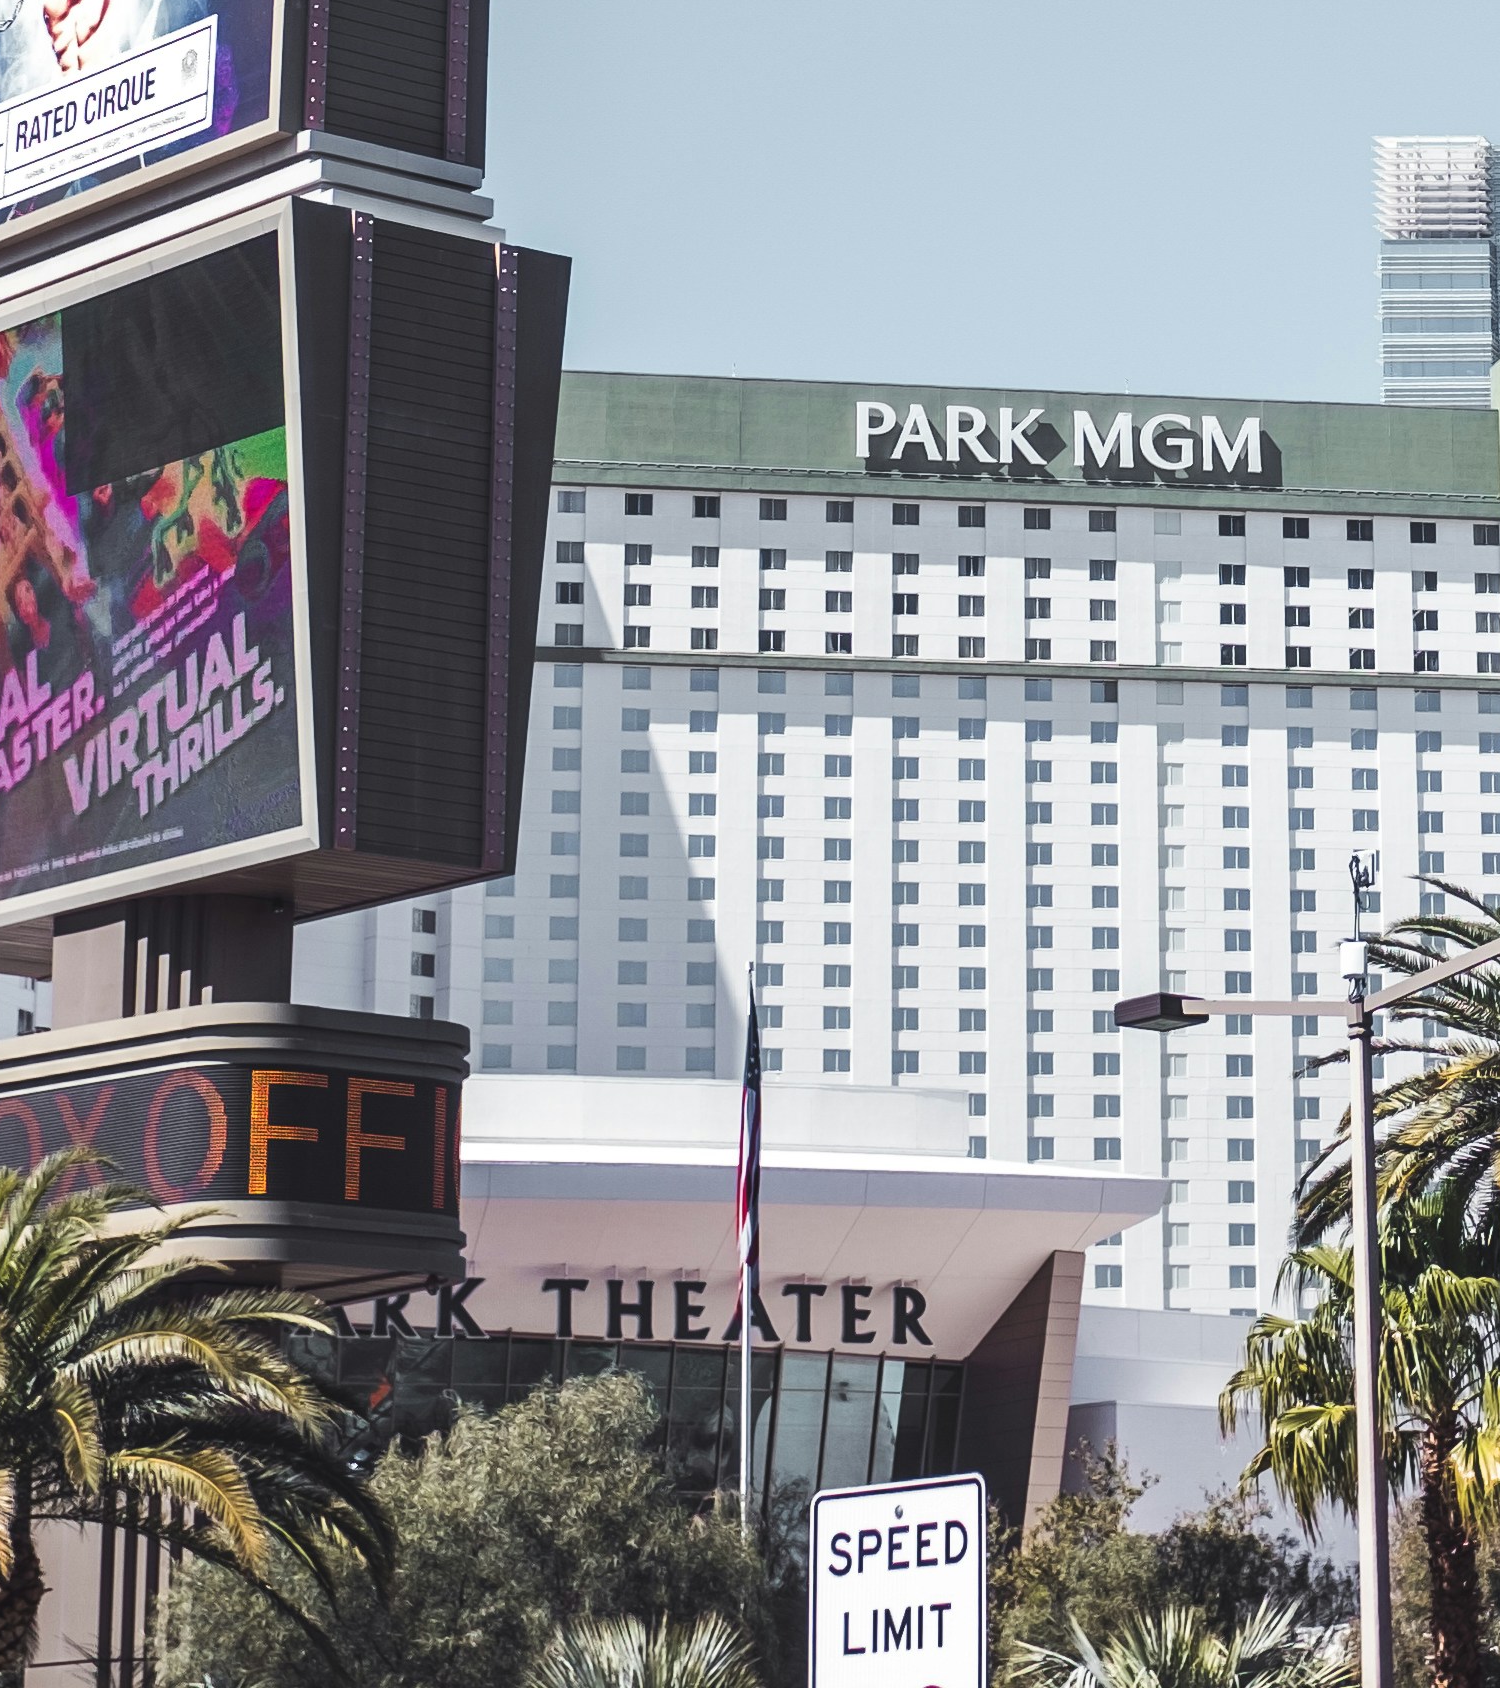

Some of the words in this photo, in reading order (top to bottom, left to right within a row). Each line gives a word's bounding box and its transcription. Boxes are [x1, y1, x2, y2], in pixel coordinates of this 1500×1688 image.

[16, 103, 77, 153] RATED
[84, 66, 157, 125] CIRQUE
[855, 400, 1048, 466] PARK
[1072, 409, 1263, 474] MGM
[62, 611, 260, 816] VIRTUAL
[131, 657, 285, 819] THRILLS.
[143, 1068, 463, 1210] OFFI
[541, 1276, 935, 1347] THEATER
[828, 1519, 968, 1577] SPEED
[842, 1602, 952, 1657] LIMIT
